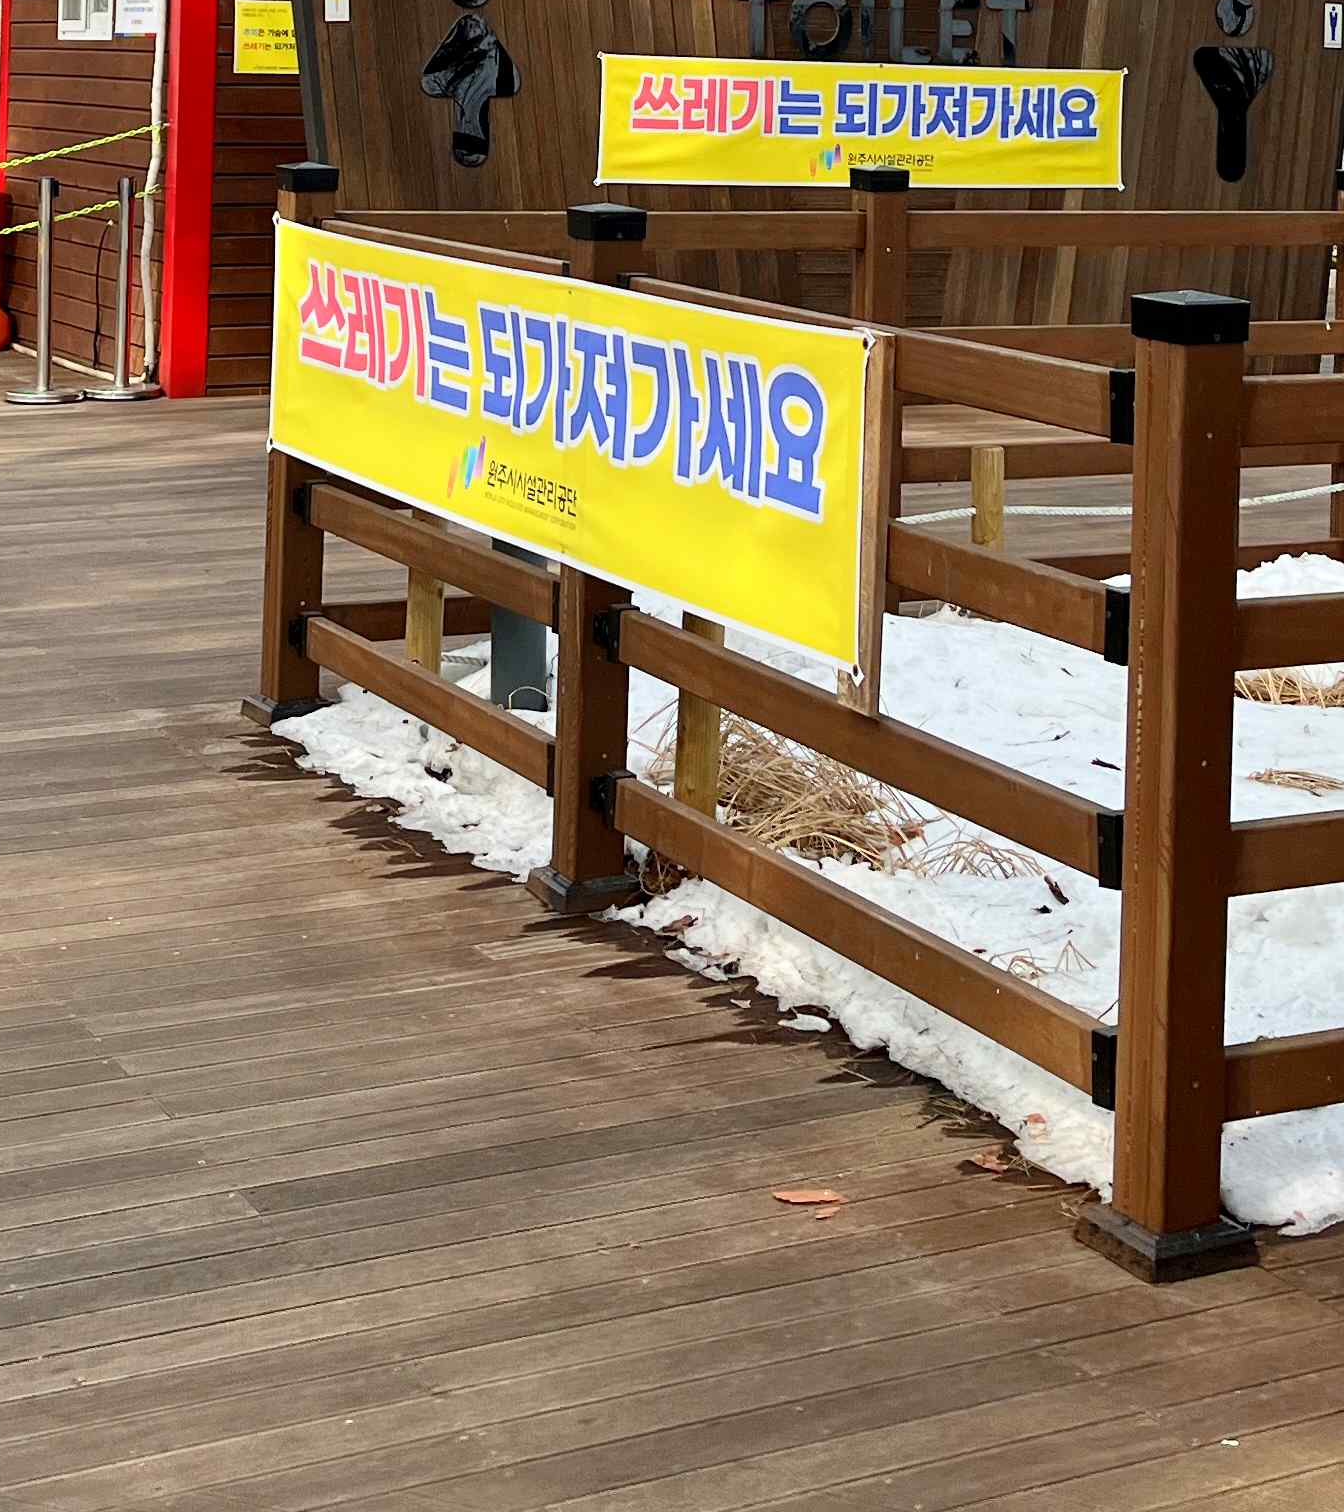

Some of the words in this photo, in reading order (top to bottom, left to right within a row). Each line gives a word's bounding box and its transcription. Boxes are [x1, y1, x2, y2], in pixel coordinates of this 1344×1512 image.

[632, 74, 822, 135] 쓰레기는
[833, 82, 1098, 140] 되가져가세요
[847, 151, 935, 167] 원주시시설관리공단
[297, 262, 470, 413] 쓰레기는
[478, 304, 826, 517] 되가져가세요
[486, 459, 577, 518] 원주시시설관리공단
